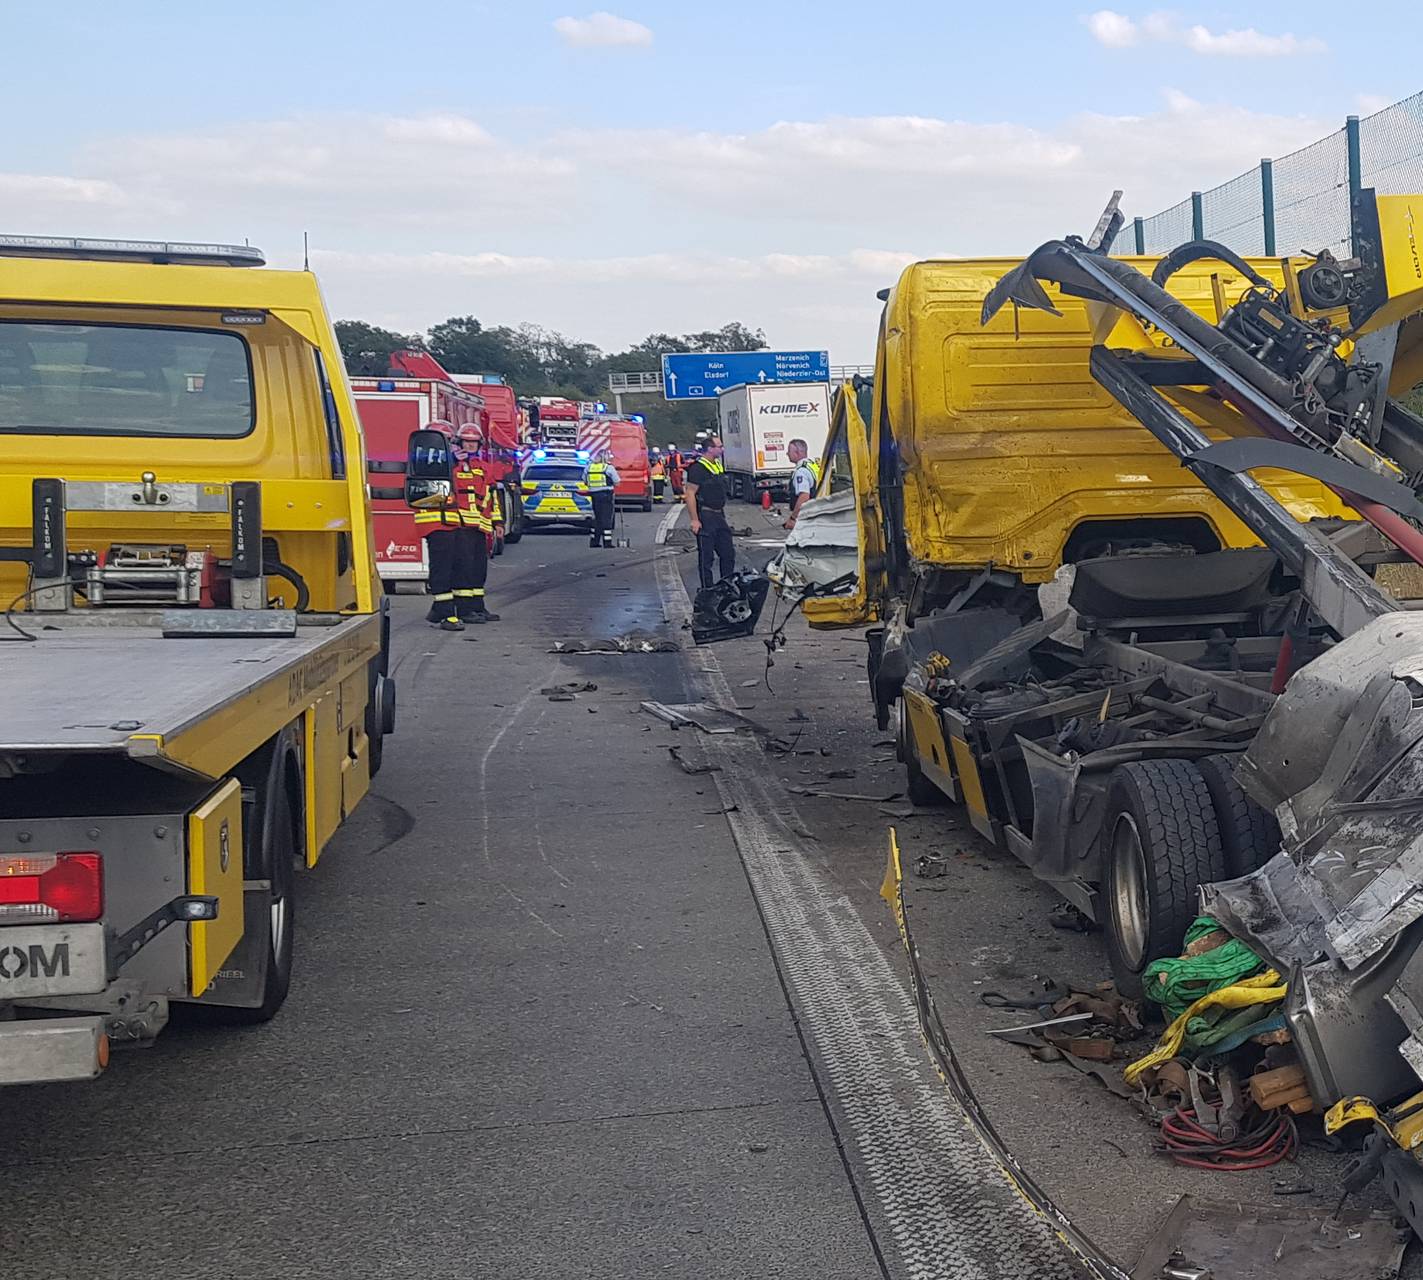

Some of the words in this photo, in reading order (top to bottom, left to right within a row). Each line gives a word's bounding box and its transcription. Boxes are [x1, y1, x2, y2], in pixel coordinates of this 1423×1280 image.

[775, 354, 810, 362] Merzenich
[708, 361, 724, 369] Köln
[775, 361, 810, 369] Nörvenich
[704, 371, 729, 379] Elsdorf
[776, 369, 826, 378] Niederzier-Ost
[759, 401, 820, 415] KOIMEX
